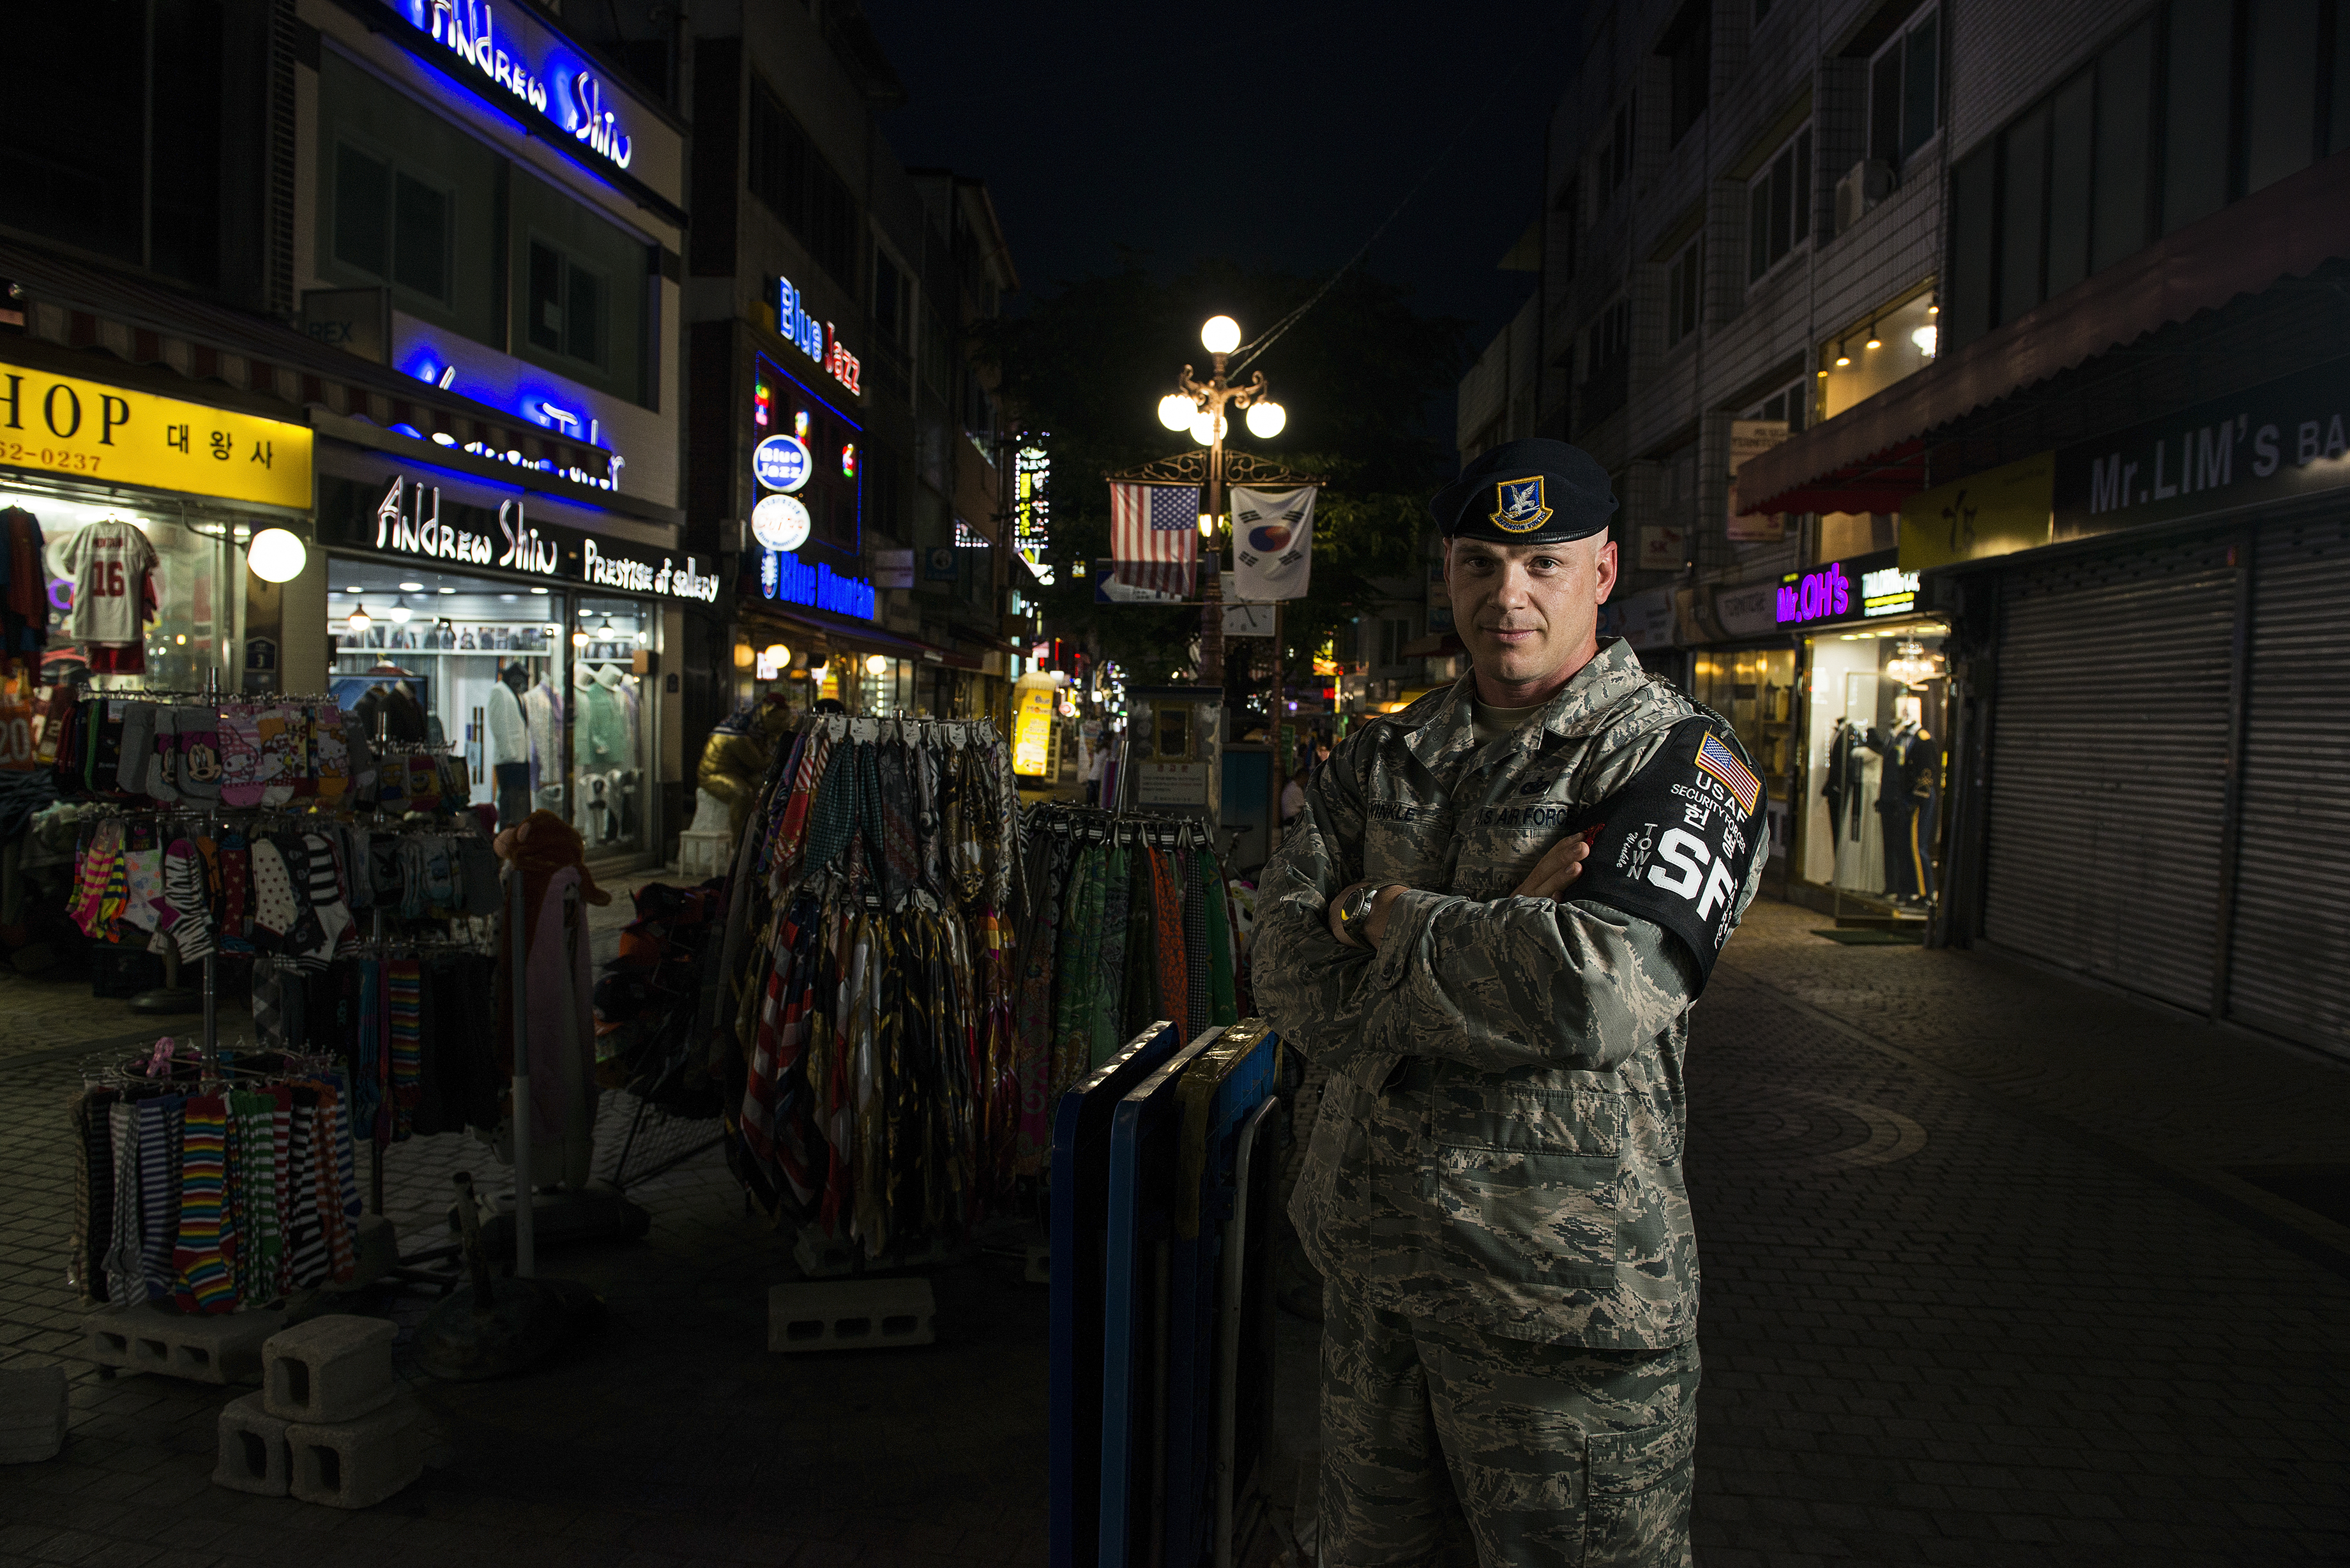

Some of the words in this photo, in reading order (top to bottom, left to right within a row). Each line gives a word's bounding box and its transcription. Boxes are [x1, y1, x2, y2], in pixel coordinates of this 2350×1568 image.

[780, 275, 822, 363] Blue
[824, 321, 861, 396] Jazz
[759, 462, 801, 479] Jazz
[760, 448, 802, 464] Blue
[93, 561, 124, 596] 16
[655, 557, 672, 595] of
[1494, 808, 1520, 825] AIR
[1522, 807, 1573, 826] FORC
[1670, 783, 1725, 818] SECURITY
[1724, 813, 1746, 855] FORCES
[1695, 771, 1748, 824] USAF
[1626, 823, 1658, 880] TOWN
[1647, 827, 1735, 922] SF
